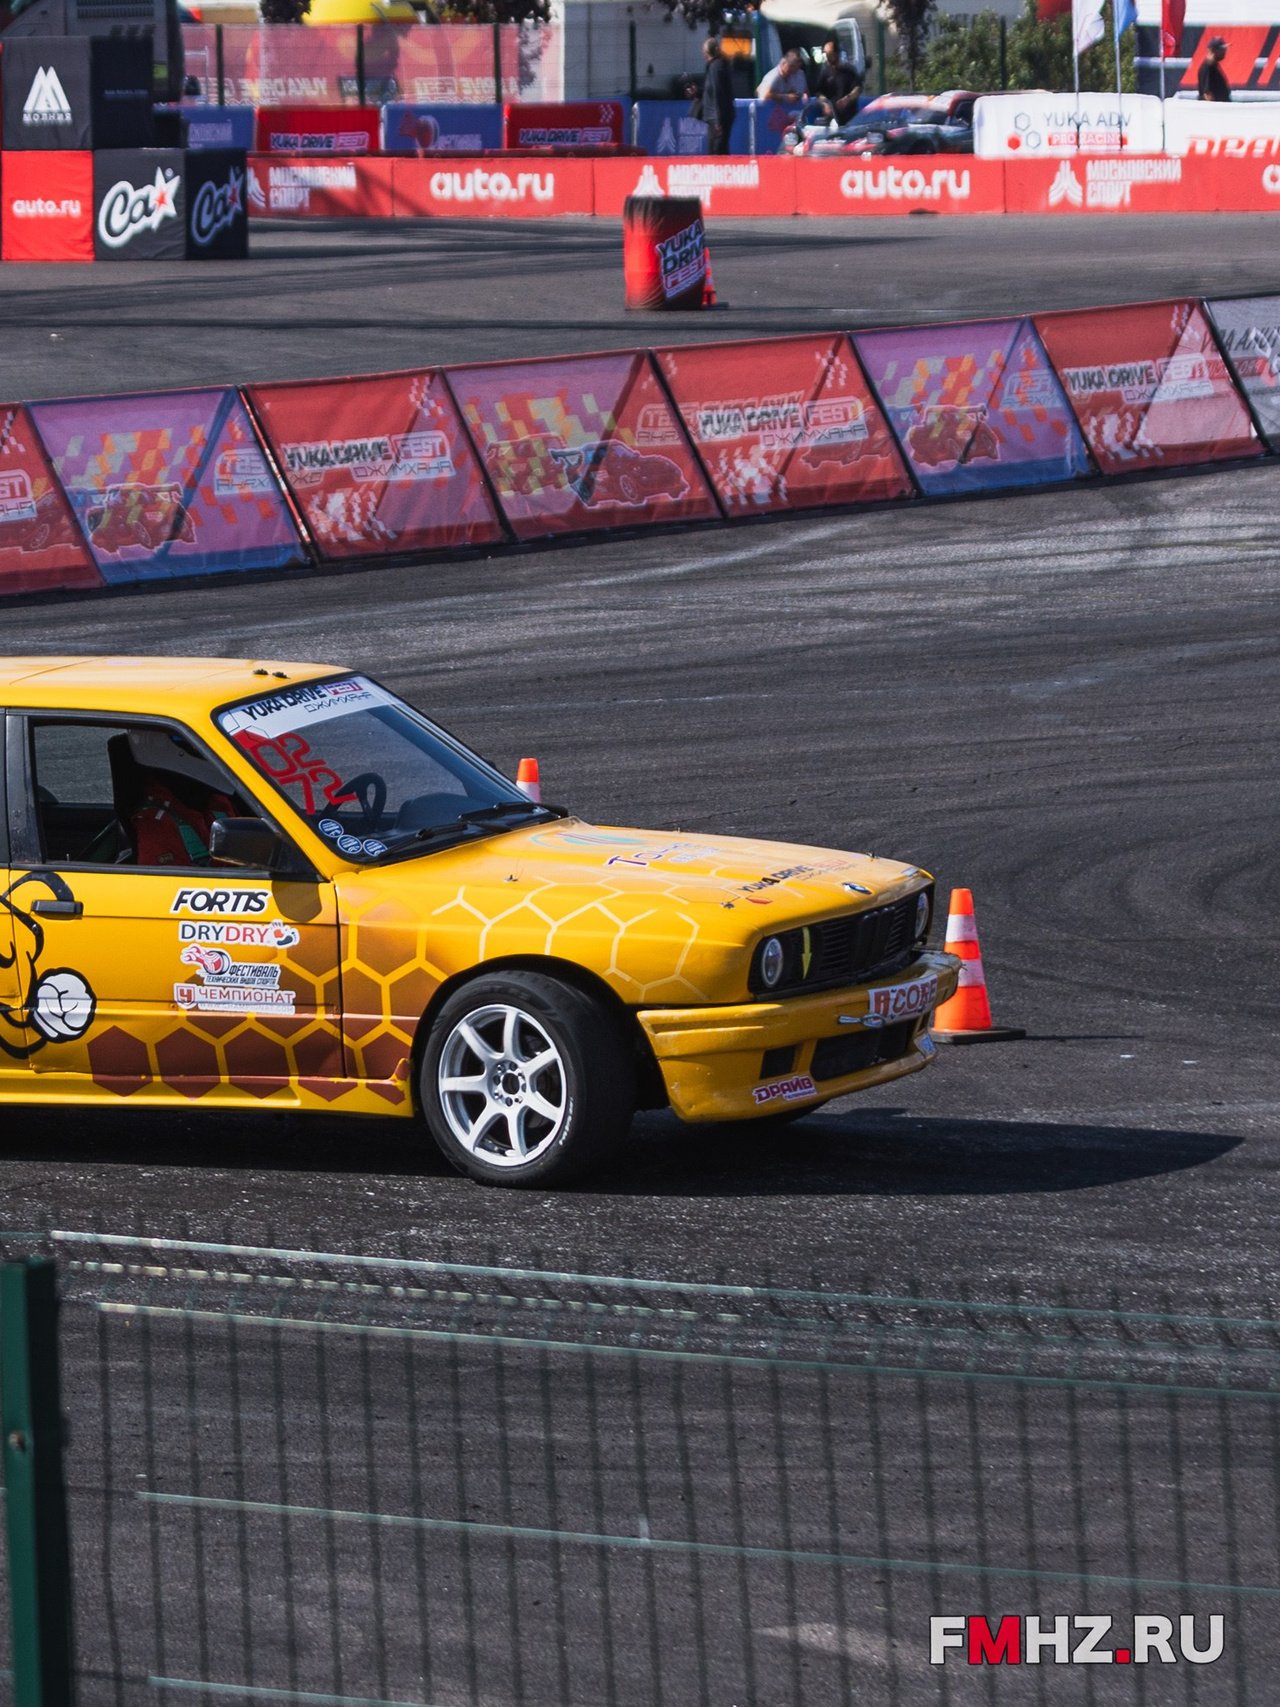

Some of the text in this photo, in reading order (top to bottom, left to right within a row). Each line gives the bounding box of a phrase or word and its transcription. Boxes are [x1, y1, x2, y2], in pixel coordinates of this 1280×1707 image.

[23, 112, 72, 123] МОЛНИЯ
[1043, 112, 1131, 127] YUKA ADV
[271, 136, 299, 149] YUKA
[300, 135, 334, 148] DRIVE
[520, 129, 547, 143] YUKA
[548, 129, 579, 143] DRIVE
[1086, 157, 1182, 183] МОСКОВСКИЙ
[431, 168, 554, 201] auto.ru
[841, 166, 970, 198] auto.ru
[12, 198, 81, 215] auto.ru
[658, 220, 702, 257] YUKA
[1065, 369, 1106, 391] YUKA
[1108, 365, 1156, 387] DRIVE
[809, 406, 856, 424] FEST
[398, 438, 444, 458] FEST
[242, 700, 287, 721] YUKA
[282, 685, 328, 707] DRIVE
[173, 891, 269, 912] FORTIS
[181, 924, 269, 943] DRYDRY
[228, 965, 279, 979] ФЕСТИВАЛЬ
[199, 987, 294, 1003] ЧЕМПИОНАТ
